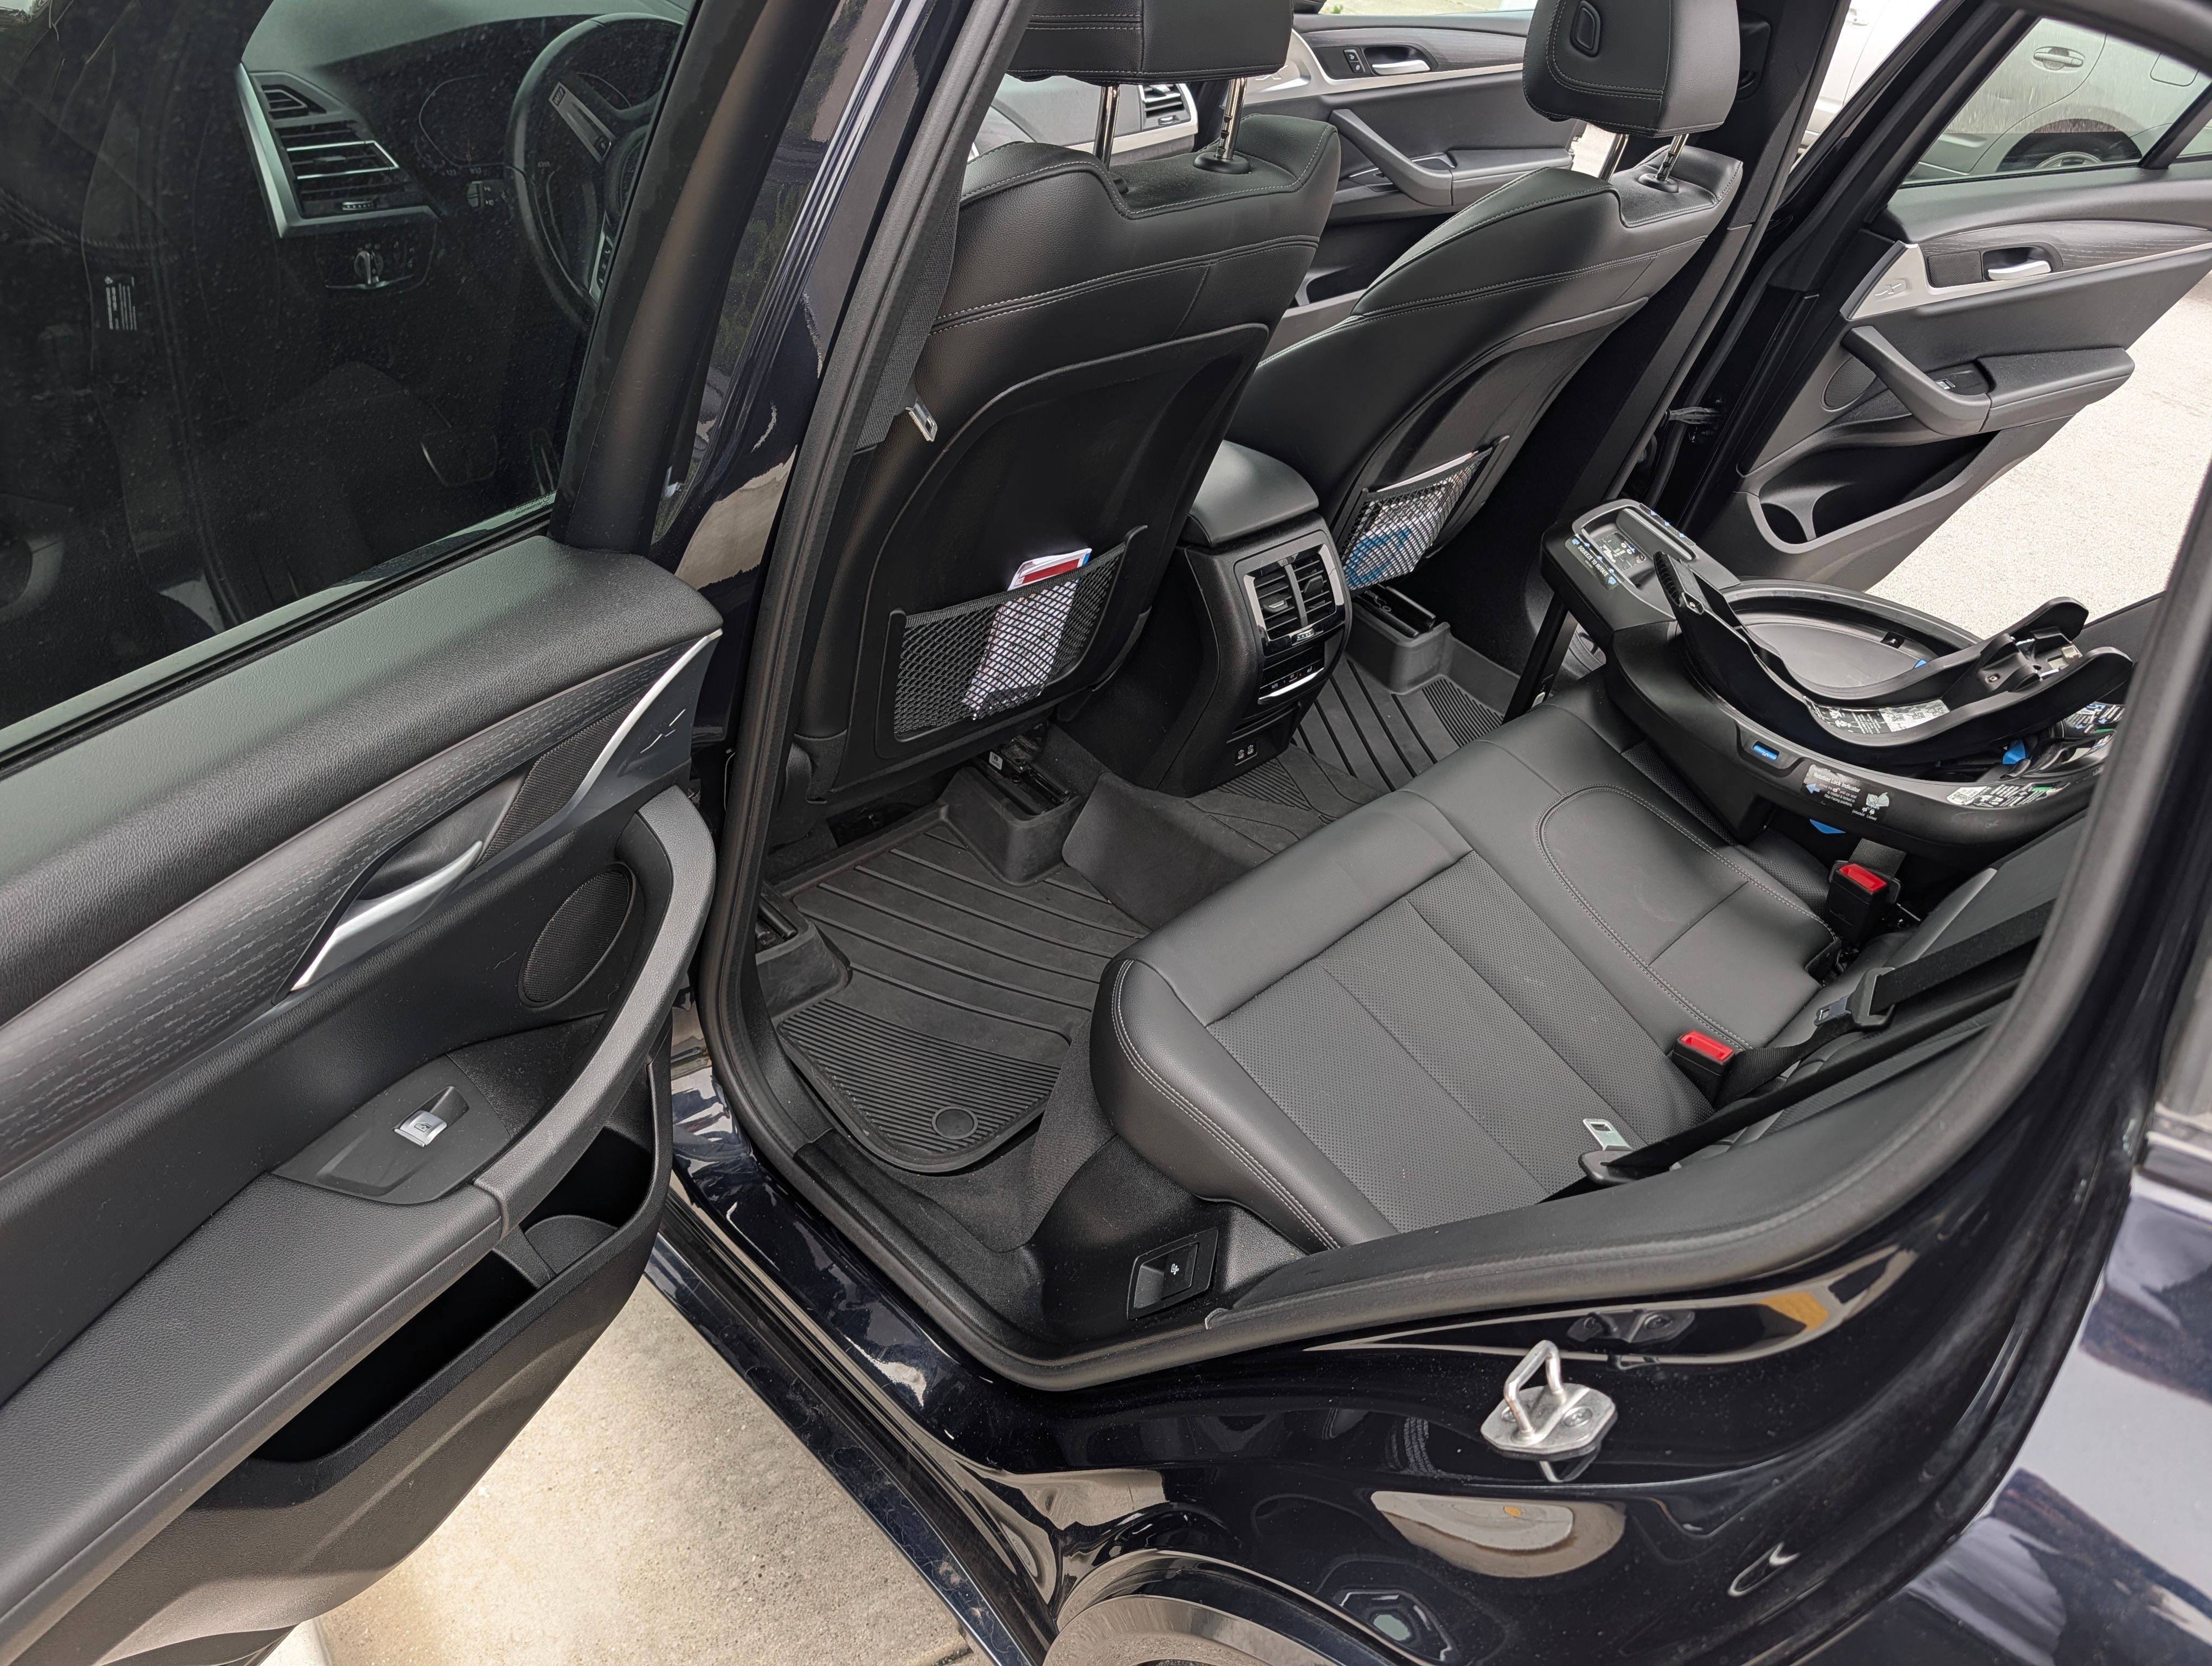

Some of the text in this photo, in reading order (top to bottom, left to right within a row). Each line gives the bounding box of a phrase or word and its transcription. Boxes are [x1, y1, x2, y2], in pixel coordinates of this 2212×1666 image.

[1578, 545, 1592, 561] SQUEEZE
[1595, 563, 1609, 577] ROTATE
[1813, 772, 1830, 782] Rotation
[1830, 778, 1841, 786] Lock
[1841, 782, 1861, 793] Indicator
